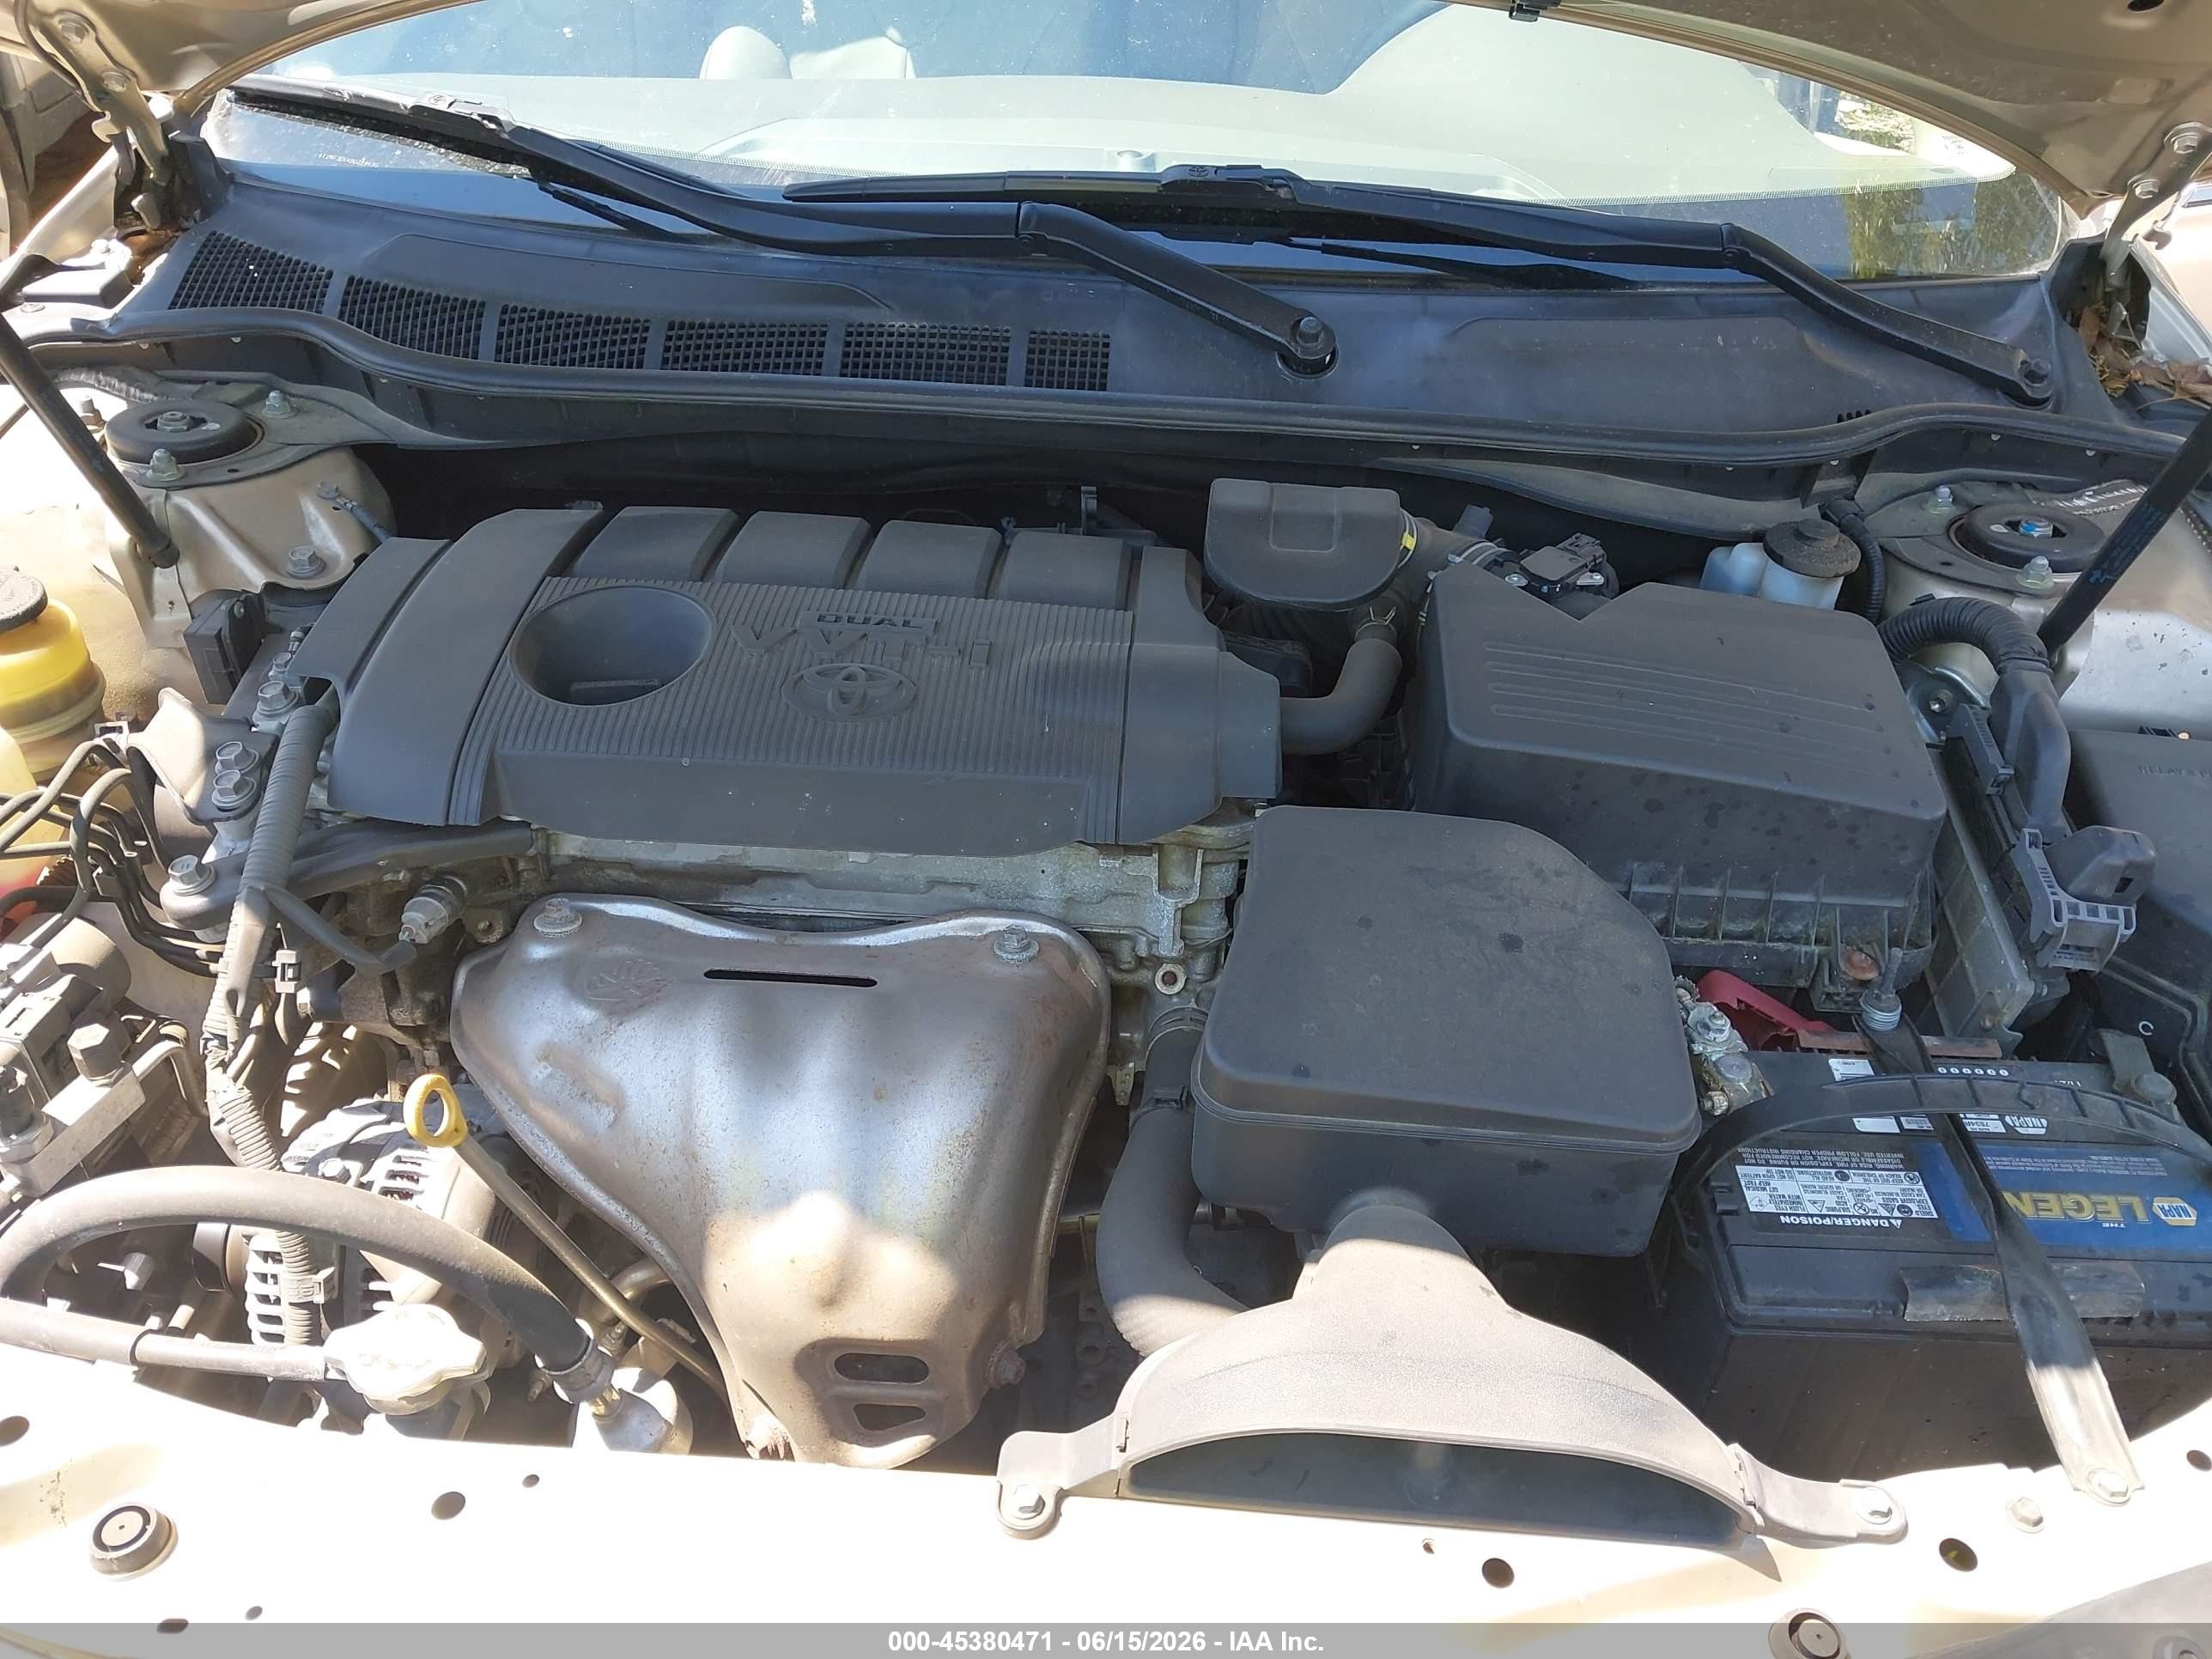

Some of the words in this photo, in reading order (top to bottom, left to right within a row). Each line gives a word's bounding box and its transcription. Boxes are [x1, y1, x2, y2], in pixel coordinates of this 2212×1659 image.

[816, 612, 926, 629] DUAL
[2010, 1115, 2043, 1127] NAPA
[2156, 1205, 2193, 1218] NAPA
[1780, 1216, 1889, 1228] DANGER/POISON
